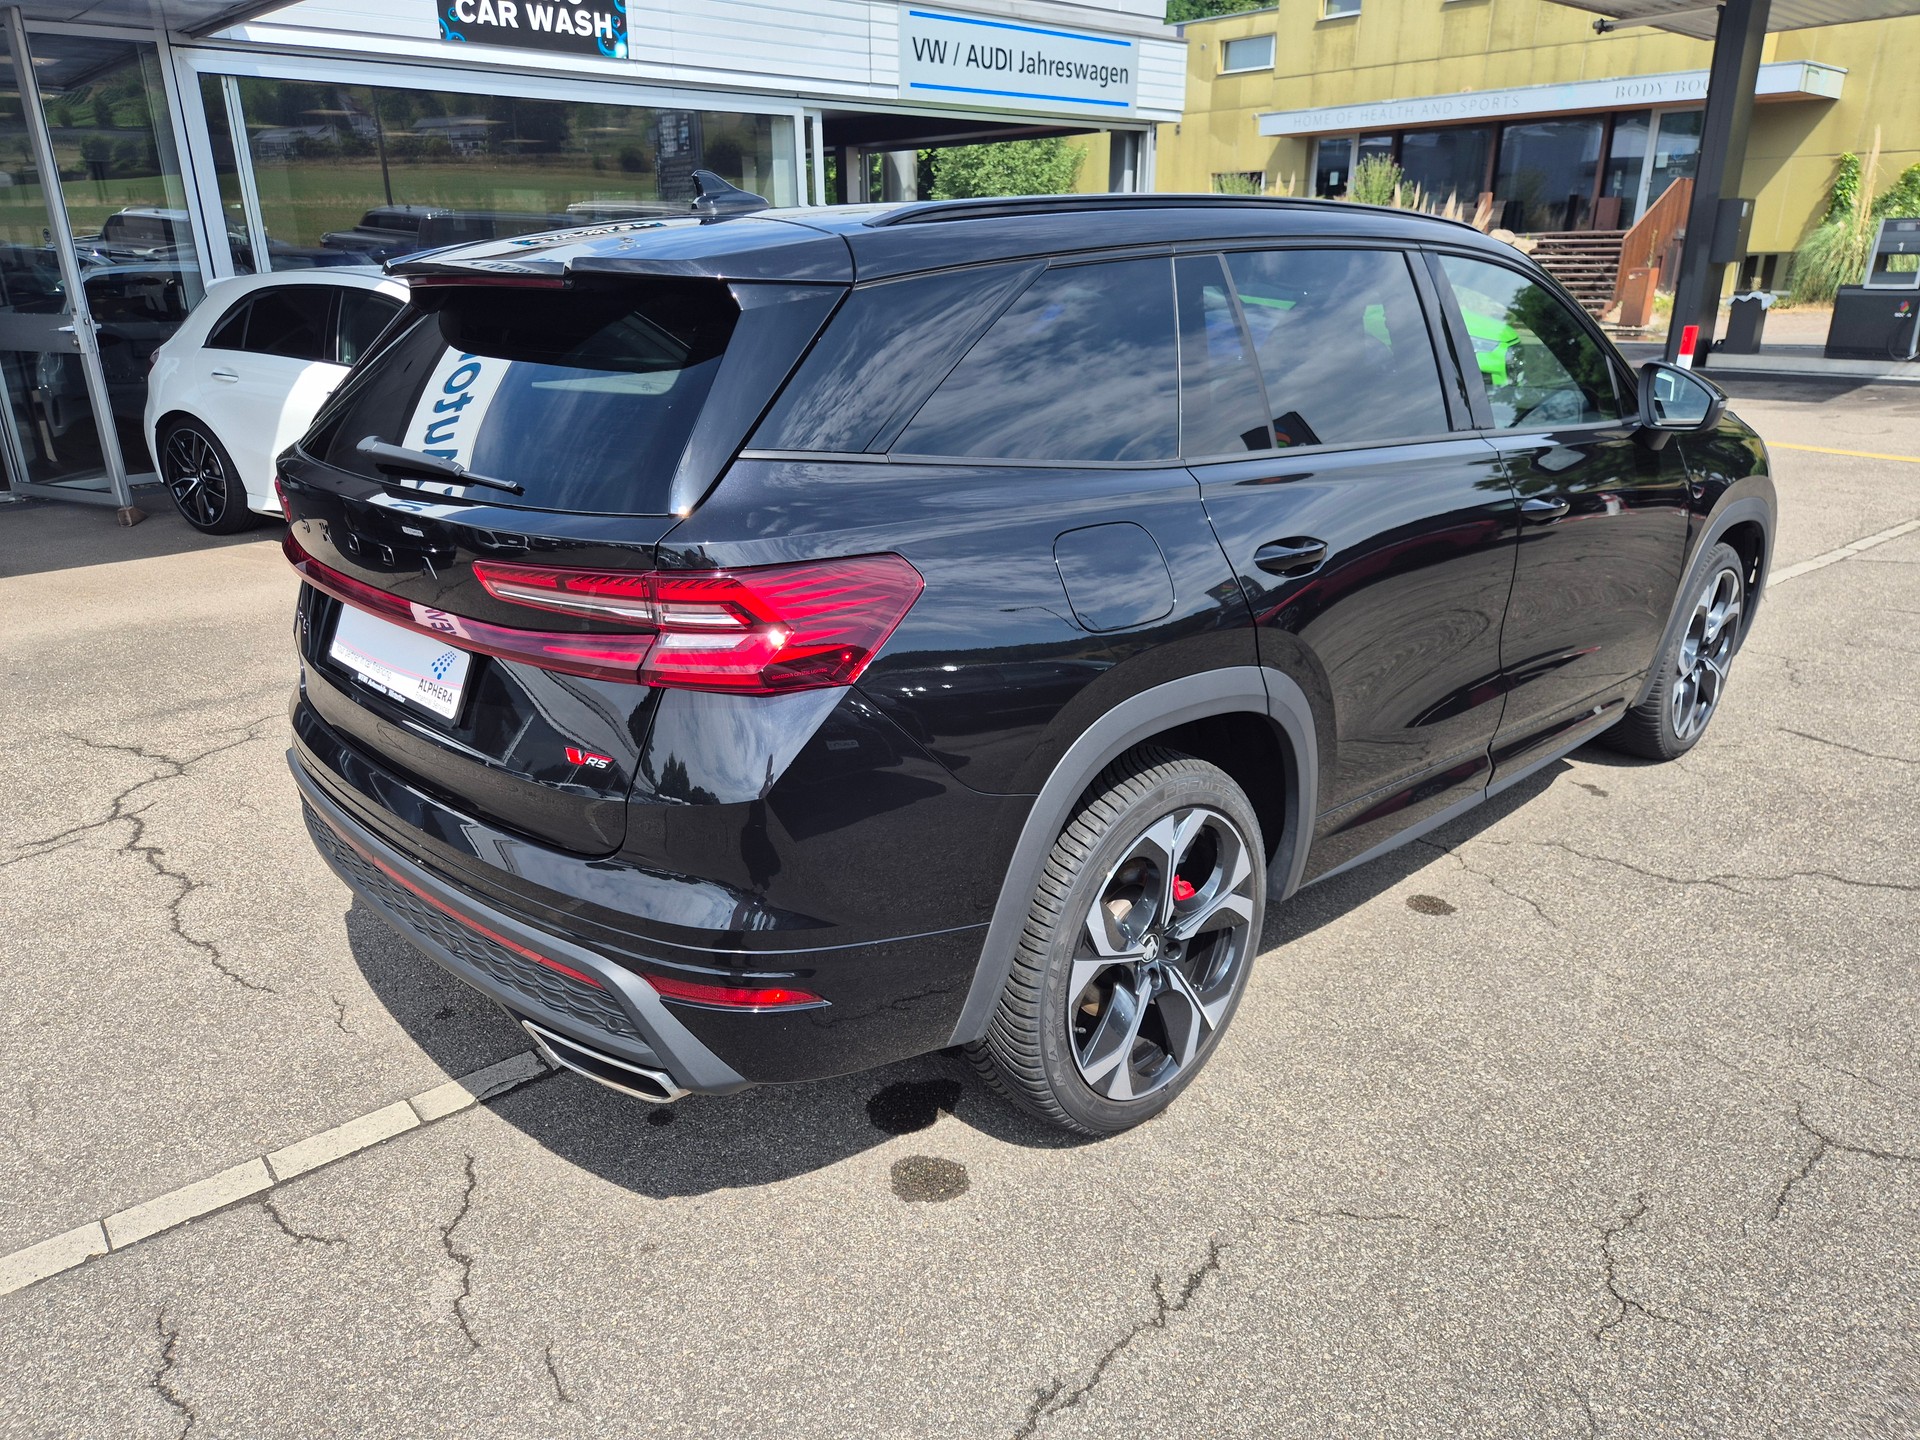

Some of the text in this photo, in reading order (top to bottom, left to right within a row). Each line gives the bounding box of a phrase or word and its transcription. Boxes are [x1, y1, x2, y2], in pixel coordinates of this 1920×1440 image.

[454, 0, 613, 39] CAR WASH
[911, 36, 947, 64] VW
[965, 44, 1012, 72] AUDI
[1018, 50, 1129, 88] Jahreswagen
[1615, 81, 1662, 99] BODY
[1293, 95, 1520, 128] HOME OF HEALTH AND SPORTS
[417, 678, 453, 705] ALPHERA
